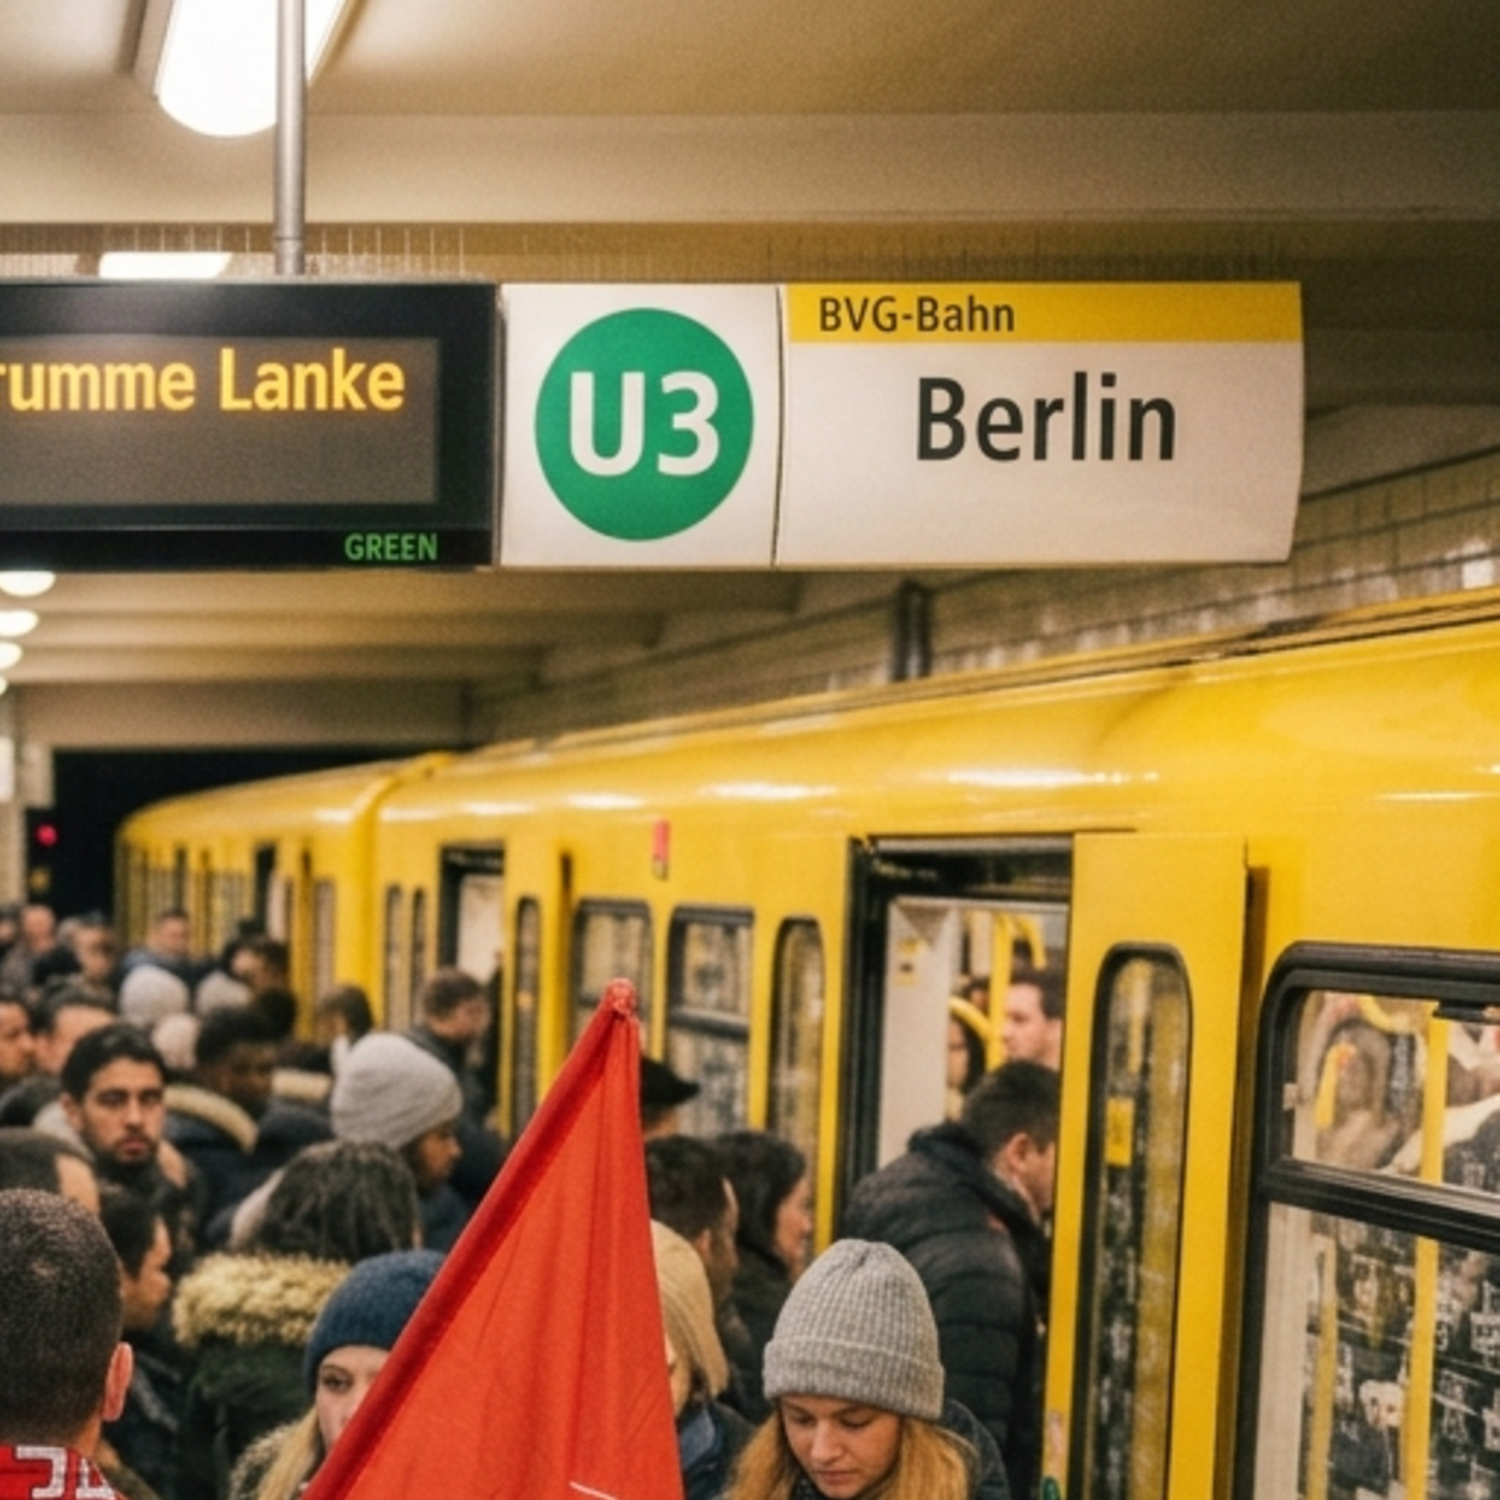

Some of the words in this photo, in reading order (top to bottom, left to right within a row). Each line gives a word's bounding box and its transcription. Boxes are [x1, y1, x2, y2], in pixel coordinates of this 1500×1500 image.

[819, 295, 1016, 333] BVG-Bahn
[218, 347, 405, 412] Lanke
[568, 371, 720, 477] U3
[916, 371, 1176, 462] Berlin
[344, 532, 438, 561] GREEN
